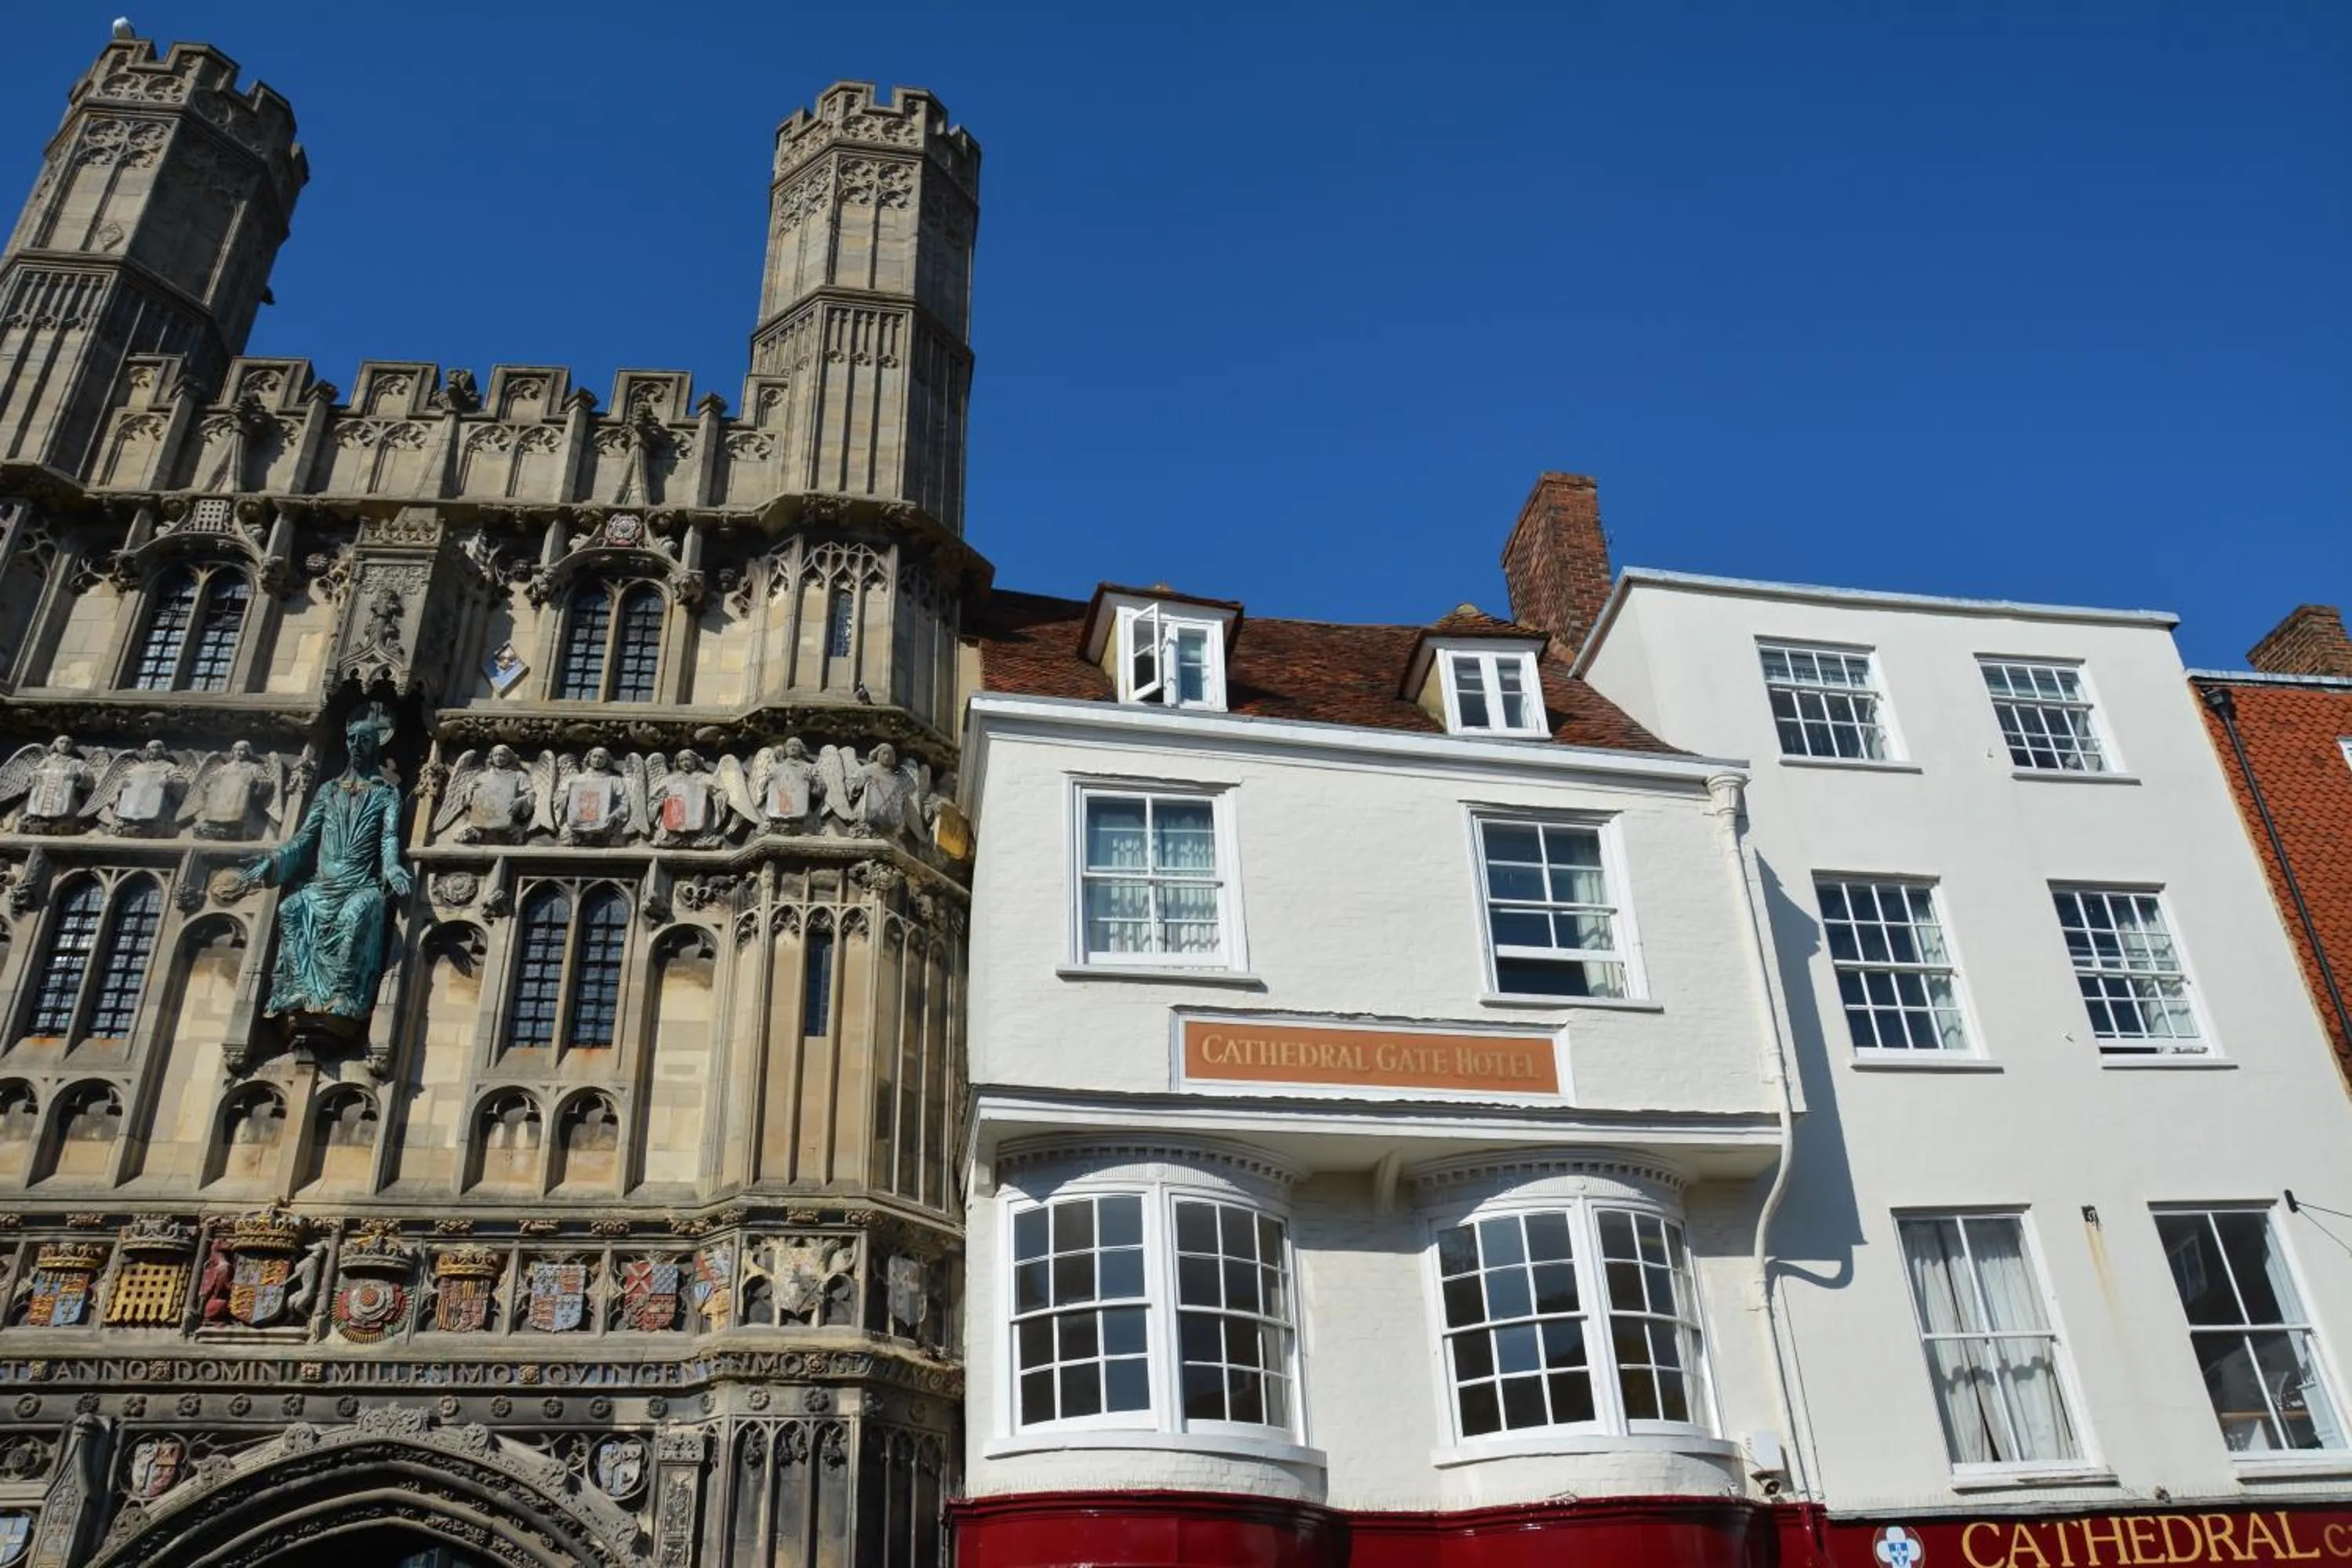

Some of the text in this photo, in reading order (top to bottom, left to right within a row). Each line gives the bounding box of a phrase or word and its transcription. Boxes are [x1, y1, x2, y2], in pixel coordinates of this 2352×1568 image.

[52, 1359, 149, 1381] ANNO
[174, 1359, 296, 1382] DOMINI
[329, 1361, 513, 1385] MILLESIMO
[1962, 1511, 2321, 1568] CATHEDRAL
